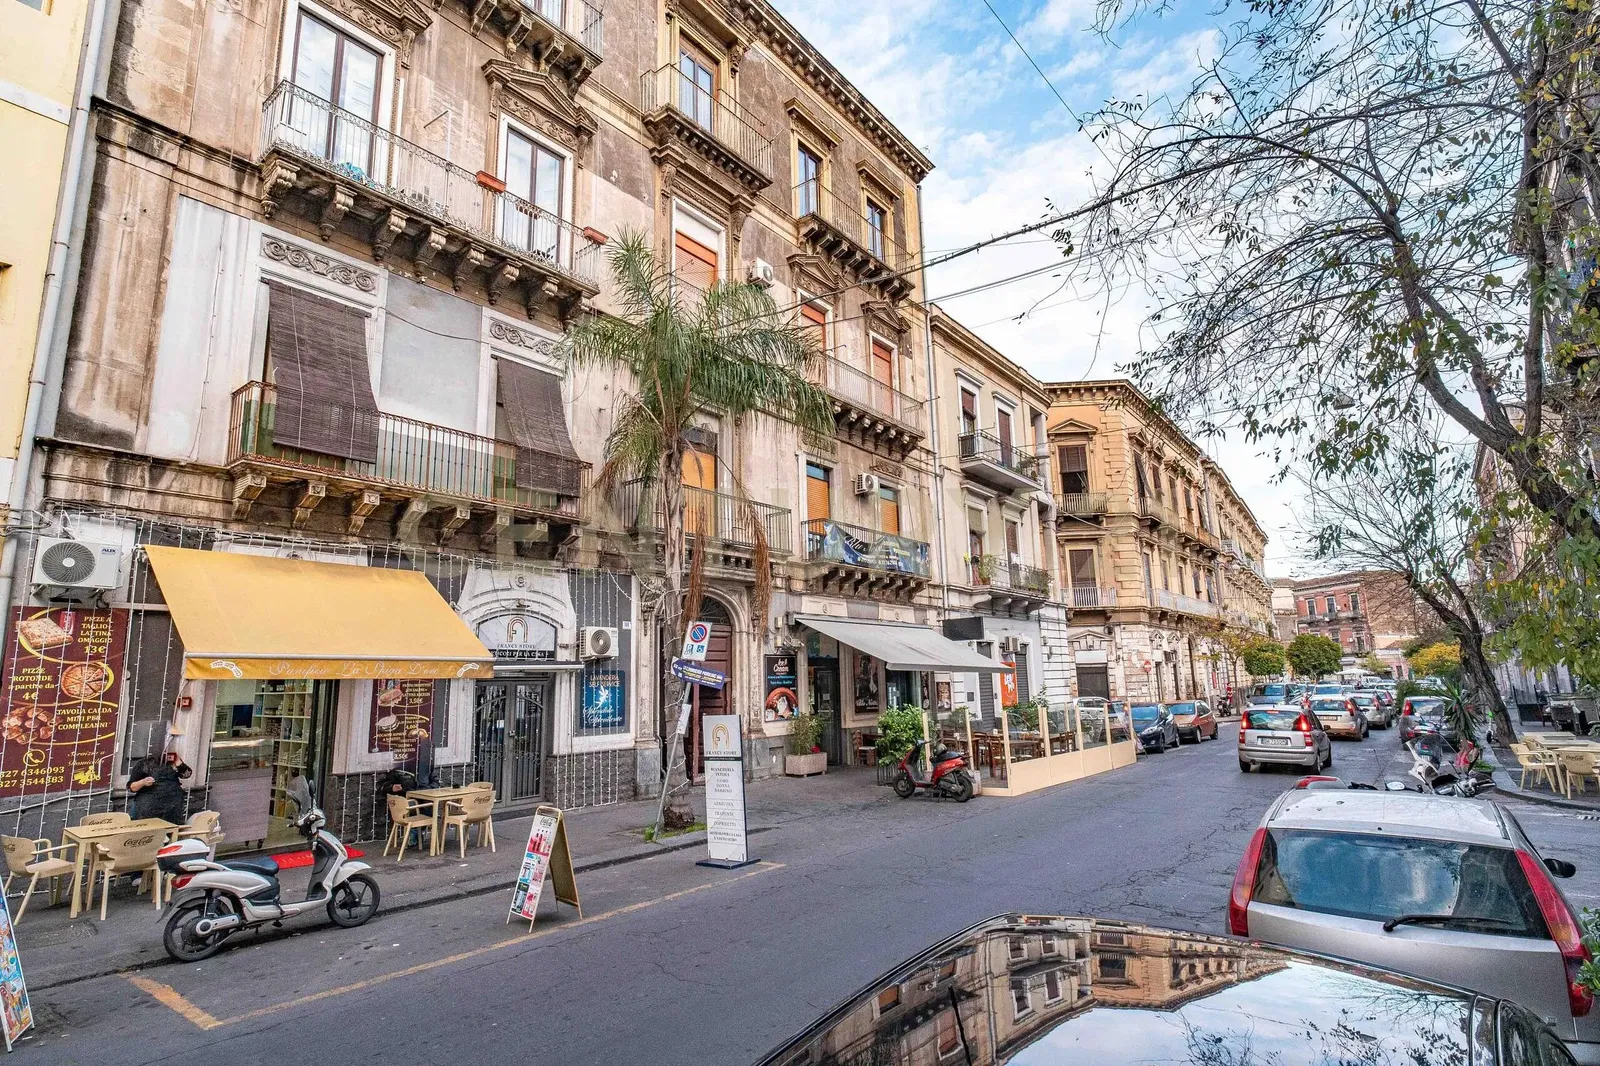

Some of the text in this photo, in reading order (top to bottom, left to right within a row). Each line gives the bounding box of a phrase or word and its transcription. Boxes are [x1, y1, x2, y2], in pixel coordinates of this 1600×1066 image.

[84, 645, 106, 654] 13€
[336, 661, 360, 677] La
[365, 661, 402, 677] Spiga
[22, 692, 38, 700] 4€
[58, 722, 108, 730] COMPLEANNI
[21, 766, 65, 776] 6346093
